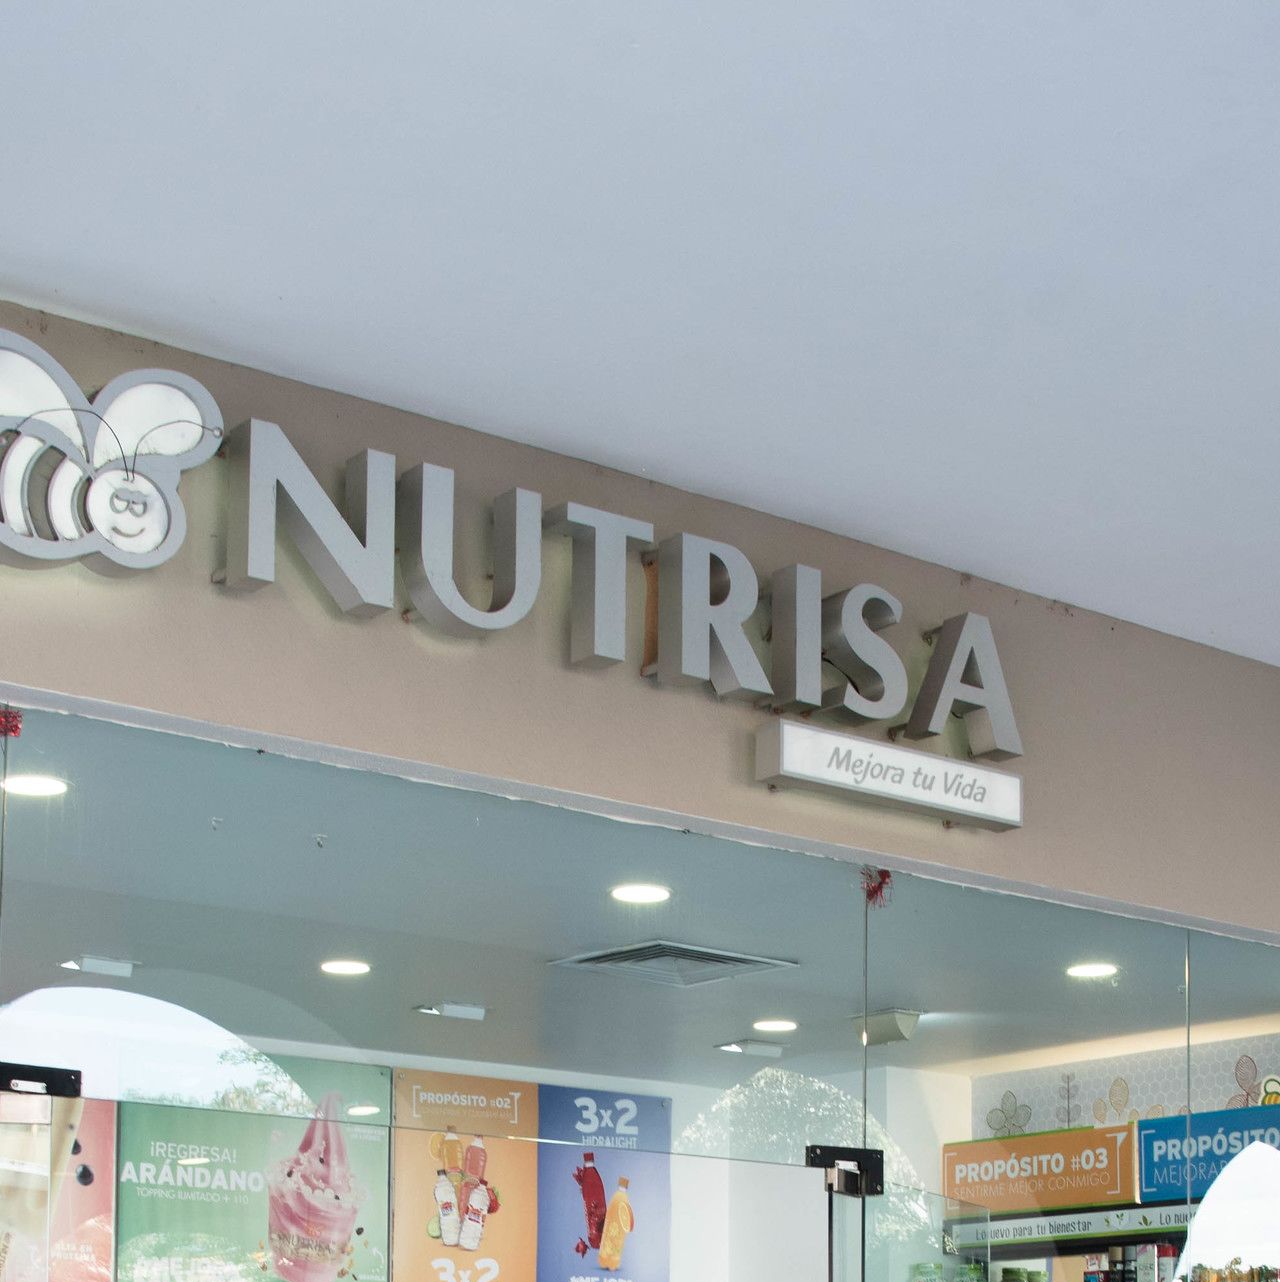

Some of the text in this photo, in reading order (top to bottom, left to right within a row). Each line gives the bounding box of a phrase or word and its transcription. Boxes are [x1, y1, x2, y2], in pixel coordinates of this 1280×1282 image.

[220, 417, 1023, 760] NUTRISA
[827, 747, 988, 803] Mejora tu Vida
[419, 1090, 487, 1107] PROPÓSITO
[574, 1096, 639, 1136] 3x2
[149, 1141, 237, 1164] ¡REGRESA!
[1152, 1126, 1280, 1163] PROPÓSITO
[120, 1158, 265, 1193] ARÁNDANO
[954, 1147, 1109, 1184] PROPÓSITO #03
[954, 1171, 1111, 1200] SENTIRME MEJOR CONMIGO
[986, 1228, 1011, 1240] uevo
[1012, 1226, 1033, 1239] para
[1036, 1223, 1047, 1235] tu
[1048, 1219, 1092, 1235] bienestar
[1159, 1211, 1172, 1226] Lo
